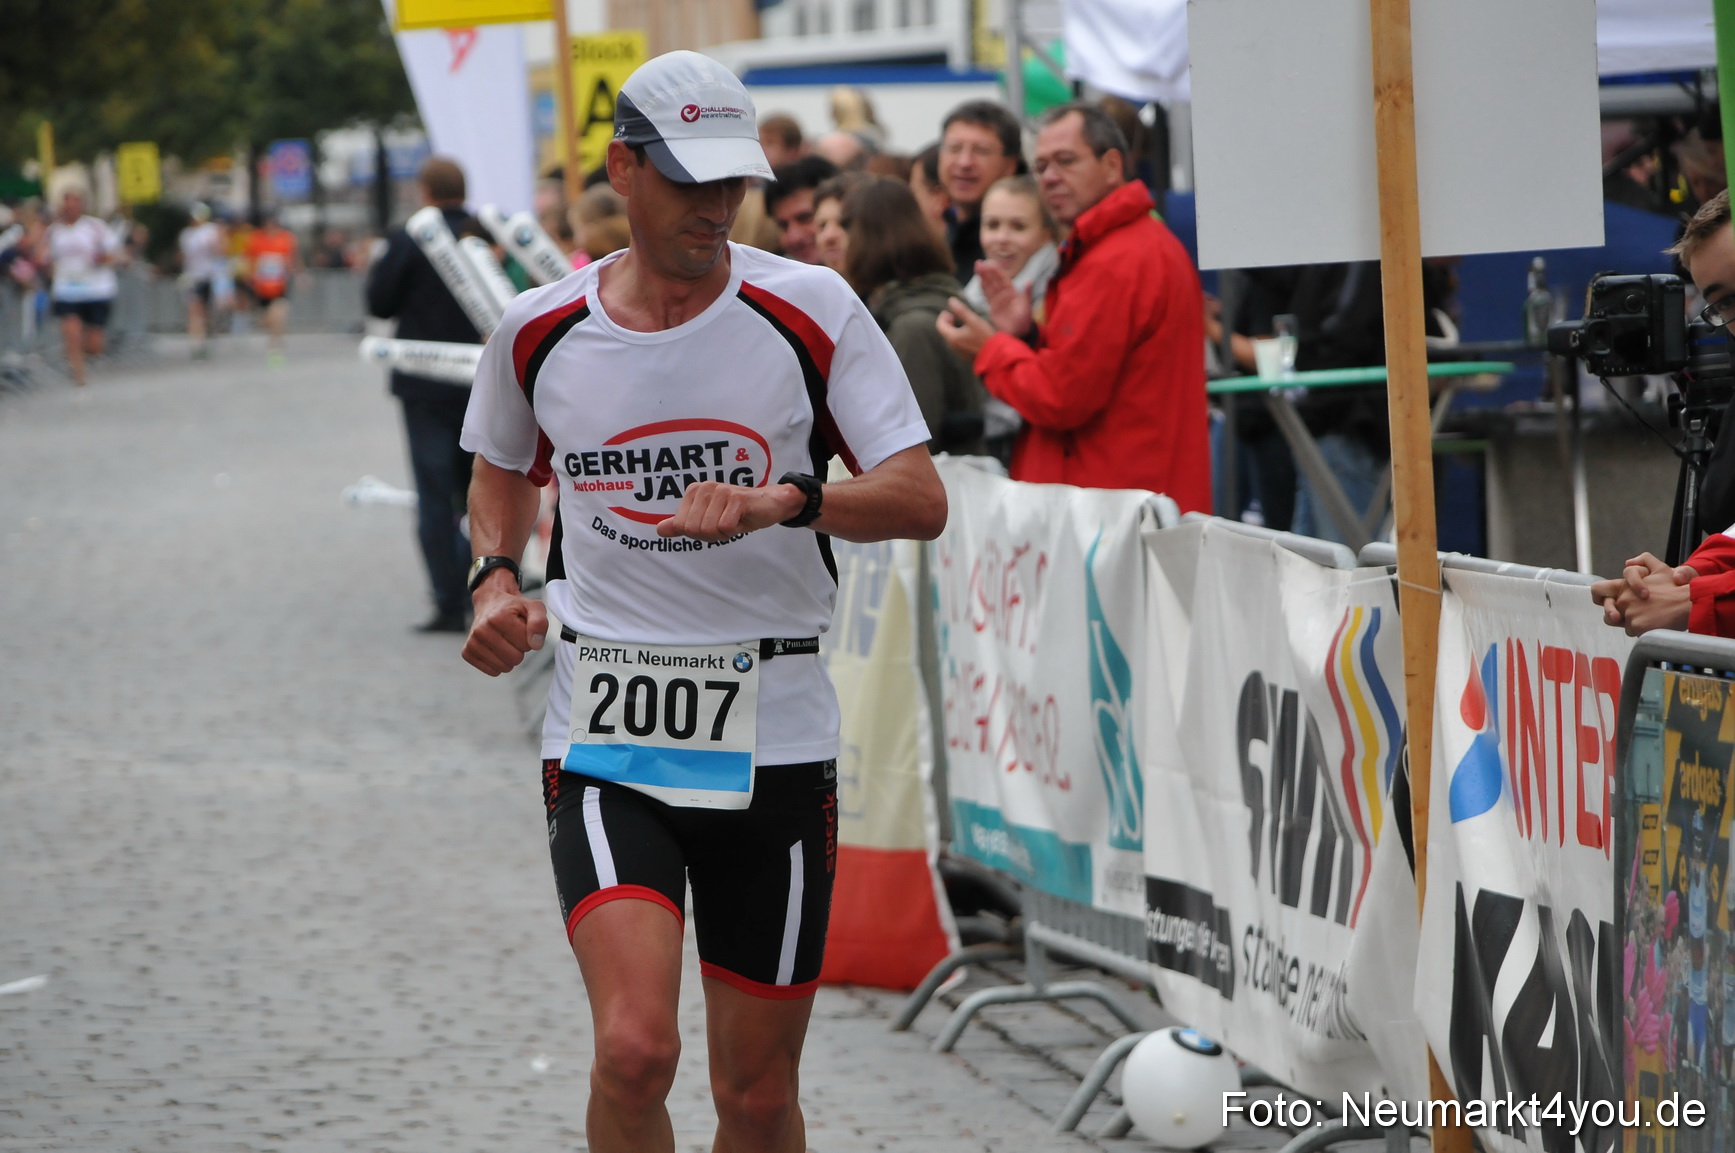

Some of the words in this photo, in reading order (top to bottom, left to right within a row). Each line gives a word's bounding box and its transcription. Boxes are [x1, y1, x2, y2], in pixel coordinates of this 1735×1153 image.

[580, 76, 616, 137] A
[564, 440, 730, 478] GERHART
[735, 447, 750, 462] &
[573, 478, 635, 493] Autohaus
[591, 515, 617, 541] Das
[619, 532, 703, 552] sportliche
[579, 646, 633, 664] PARTL
[637, 650, 725, 670] Neumarkt
[588, 672, 740, 742] 2007
[1680, 750, 1720, 817] erdgas
